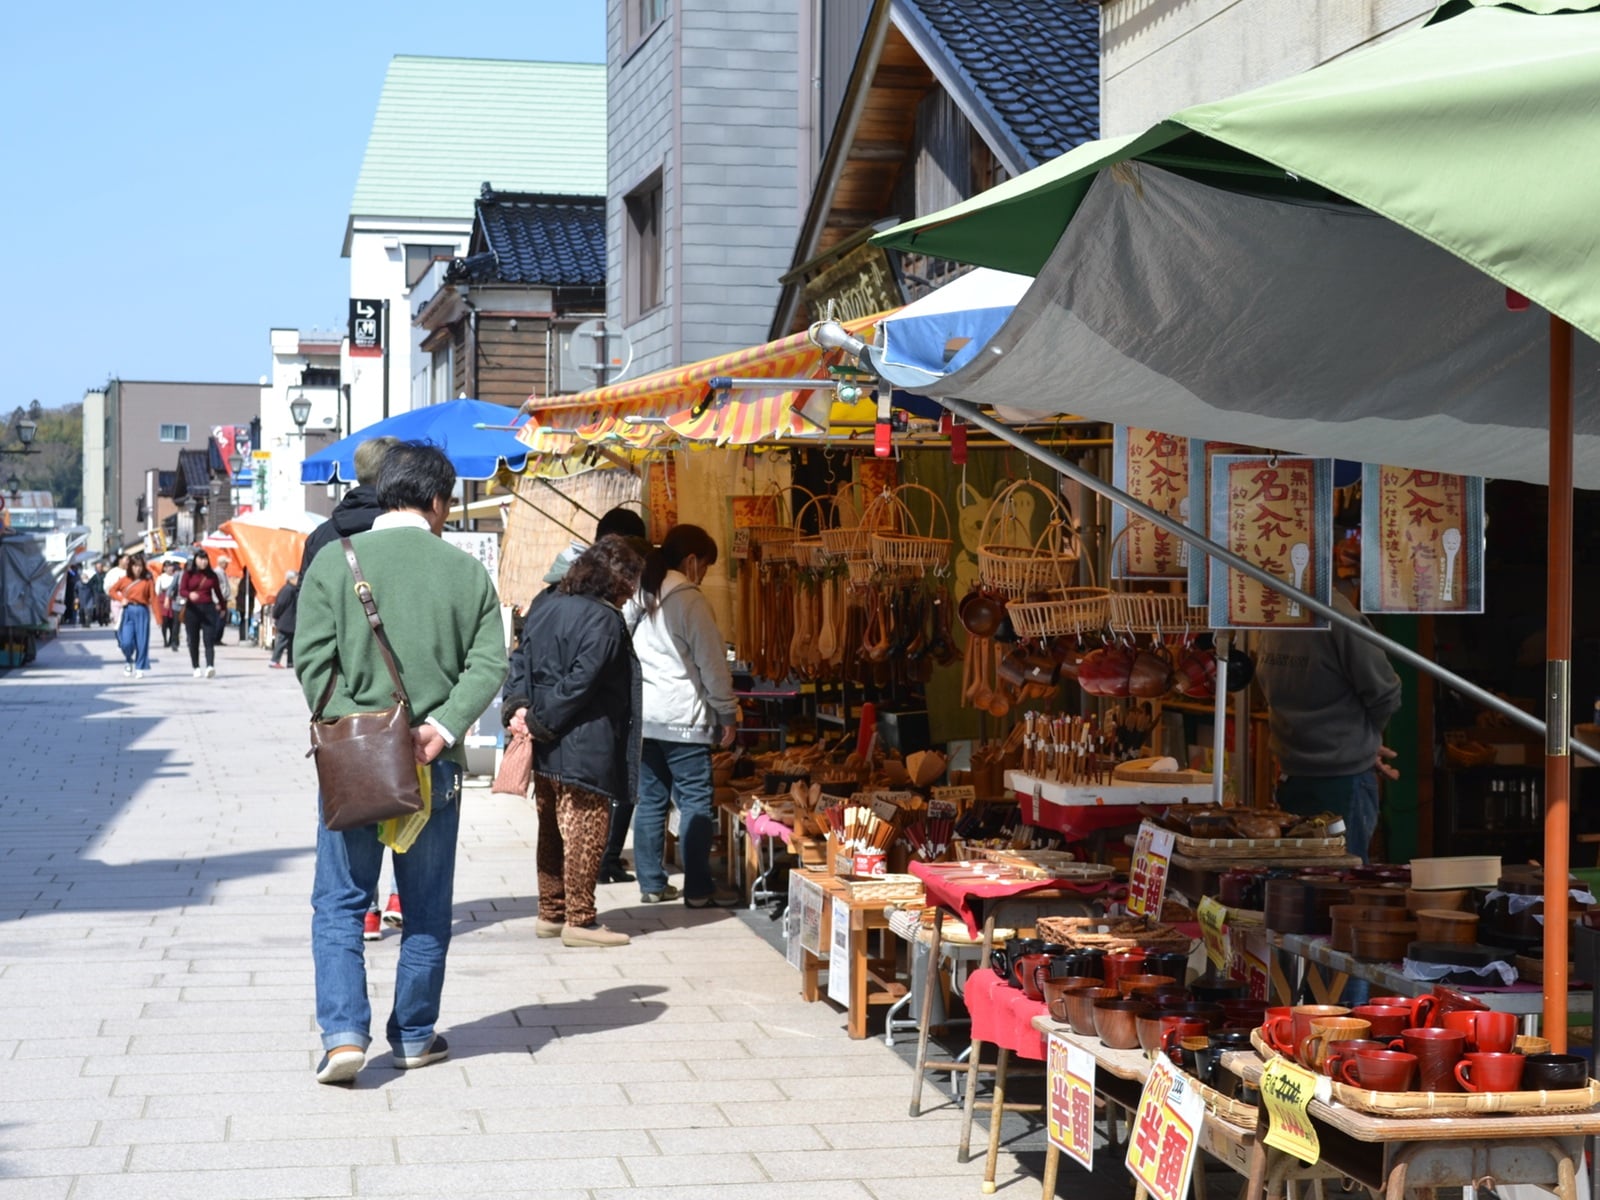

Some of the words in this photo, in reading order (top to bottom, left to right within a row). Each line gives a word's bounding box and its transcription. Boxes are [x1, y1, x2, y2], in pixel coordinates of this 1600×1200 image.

[1132, 857, 1165, 919] 半額
[1051, 1076, 1091, 1155] 半額
[1136, 1101, 1188, 1200] 半額
